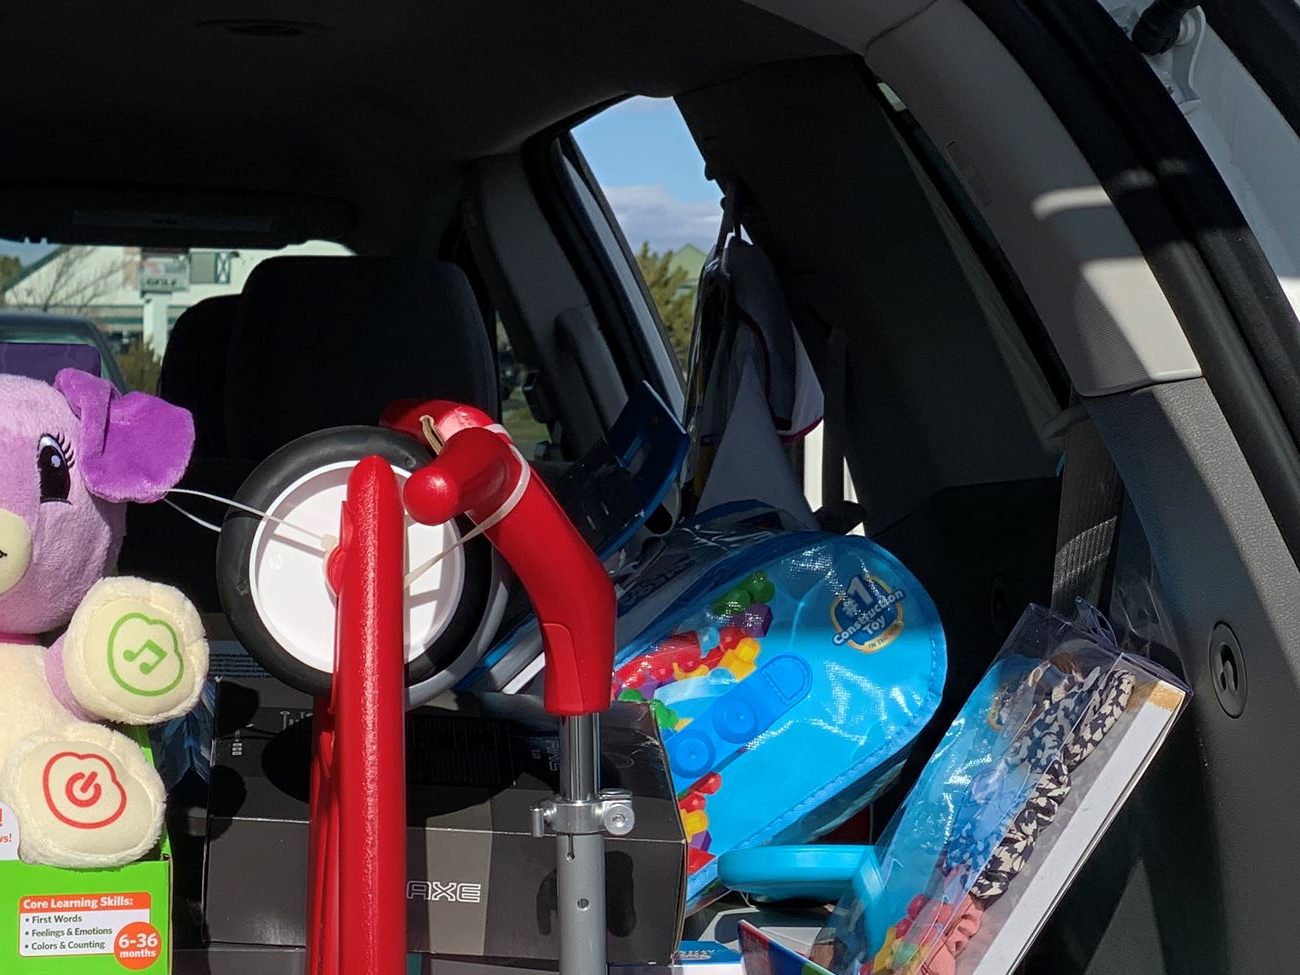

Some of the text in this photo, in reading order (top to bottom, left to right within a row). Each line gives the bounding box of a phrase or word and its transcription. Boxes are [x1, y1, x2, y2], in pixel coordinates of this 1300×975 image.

[862, 616, 886, 635] Toy
[405, 879, 482, 903] AXE
[23, 896, 134, 909] Core Learning Skills:
[32, 914, 83, 924] First Words
[31, 927, 113, 938] Feelings Emotions
[31, 940, 105, 950] Colors Counting
[118, 932, 159, 948] 6-36
[119, 949, 157, 958] months
